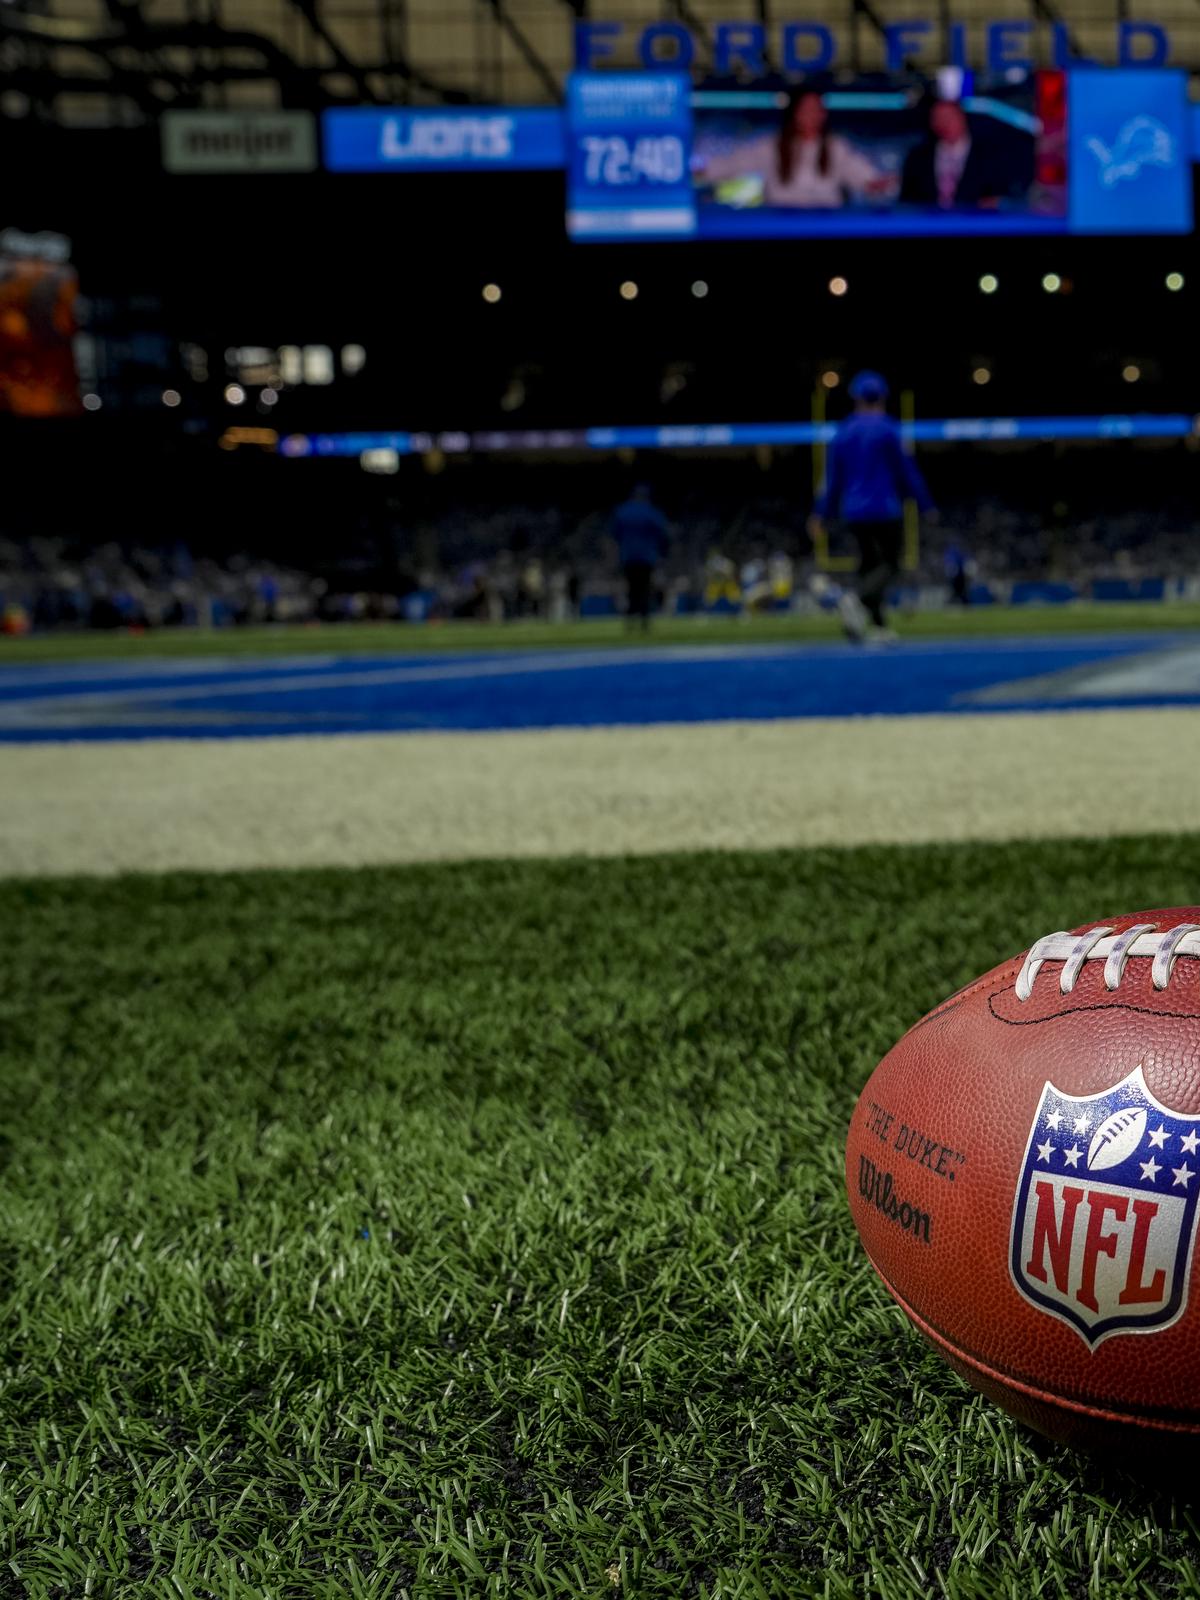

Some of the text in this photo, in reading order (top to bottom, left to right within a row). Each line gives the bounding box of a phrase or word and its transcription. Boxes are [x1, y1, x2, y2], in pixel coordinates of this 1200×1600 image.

[574, 20, 1171, 74] FORD FIELD
[380, 115, 514, 158] LIONS
[859, 1153, 931, 1243] Wilson
[1026, 1180, 1167, 1314] NFL
